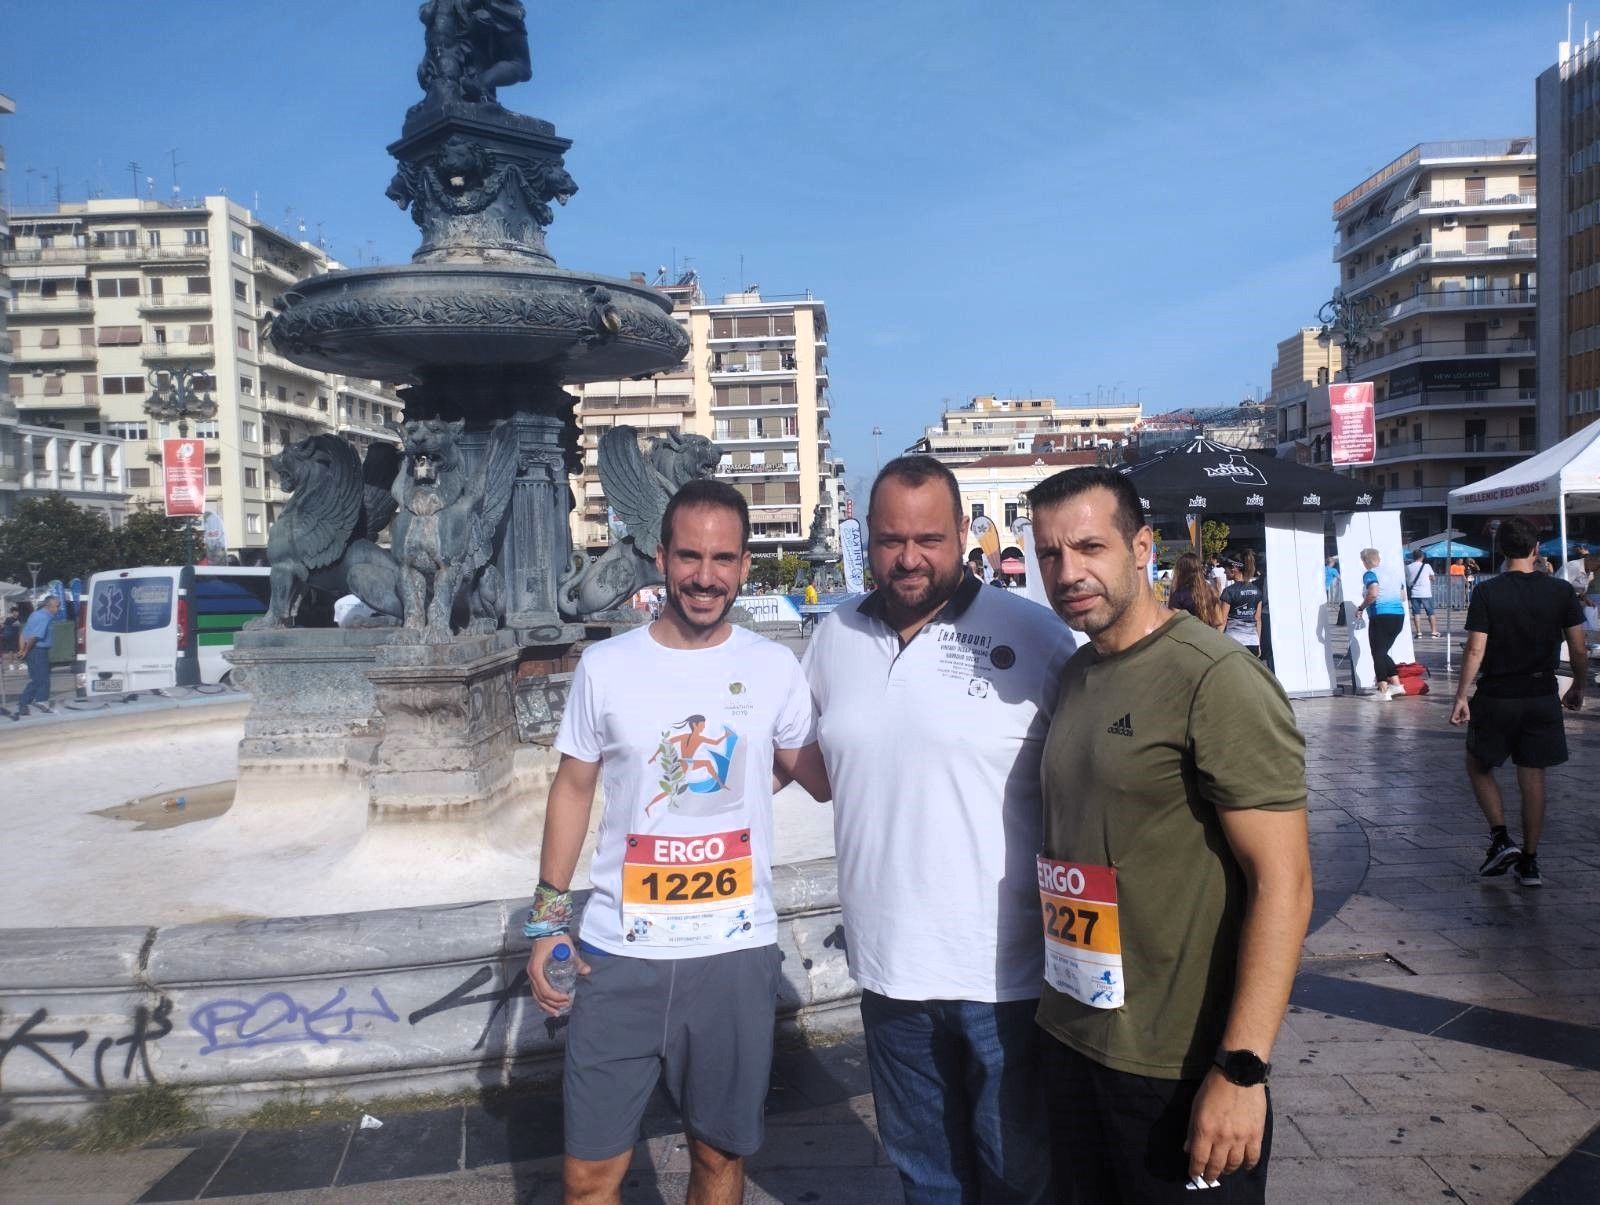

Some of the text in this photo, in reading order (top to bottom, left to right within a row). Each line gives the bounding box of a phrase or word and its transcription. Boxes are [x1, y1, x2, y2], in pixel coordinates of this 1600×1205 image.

[1464, 481, 1540, 504] HELLENIC RED CROSS
[1107, 725, 1134, 737] adidas
[654, 837, 725, 863] ERGO
[641, 867, 738, 901] 1226
[1037, 862, 1086, 895] ERGO
